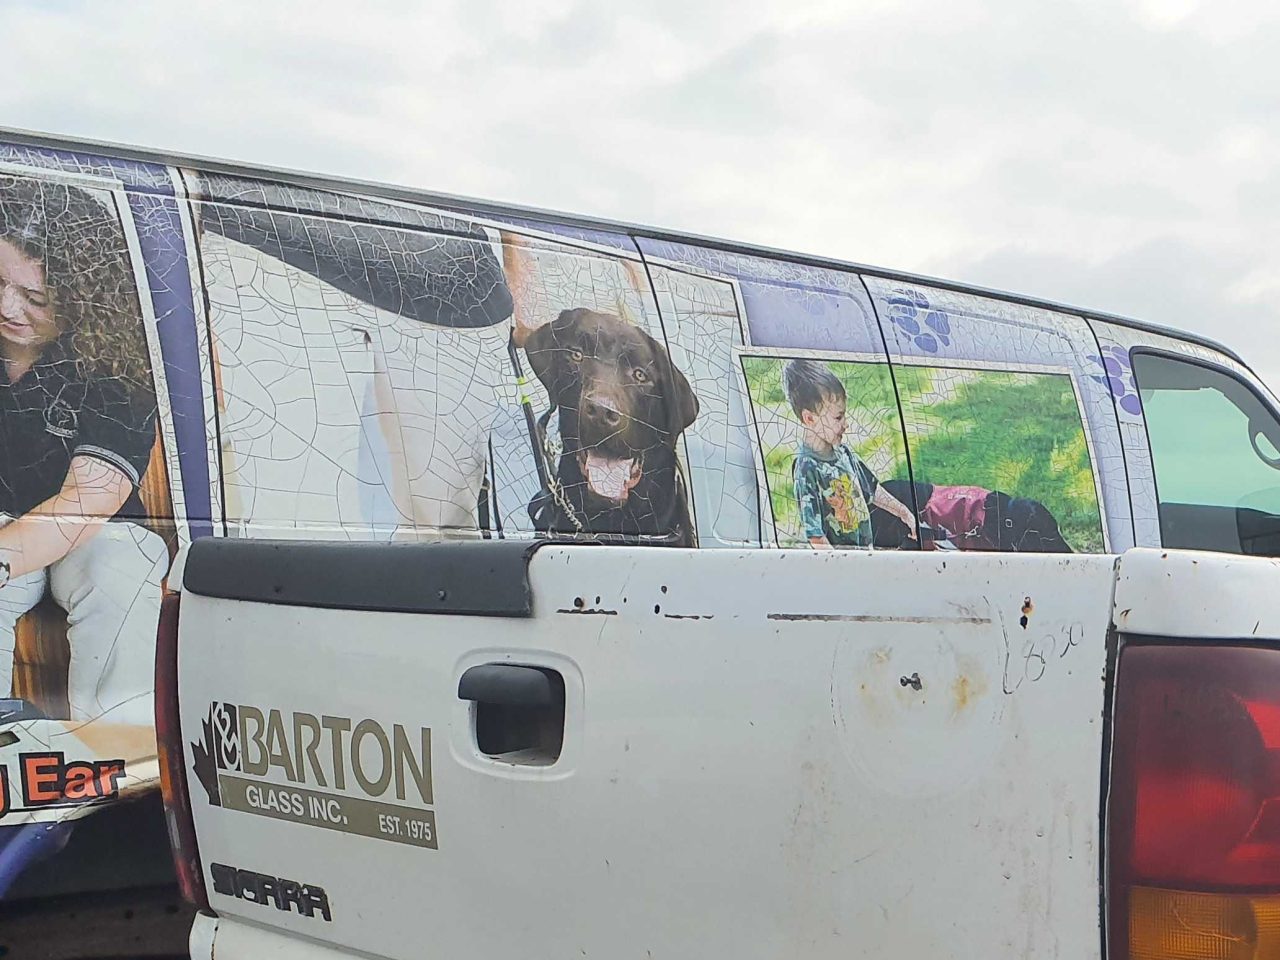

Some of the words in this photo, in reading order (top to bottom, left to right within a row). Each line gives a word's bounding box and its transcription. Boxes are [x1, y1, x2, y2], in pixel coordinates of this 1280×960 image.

[238, 704, 434, 805] BARTON
[21, 754, 125, 805] Ear
[245, 785, 304, 816] GLASS
[309, 796, 348, 825] INC.
[378, 814, 403, 836] EST.
[405, 820, 432, 841] 1975
